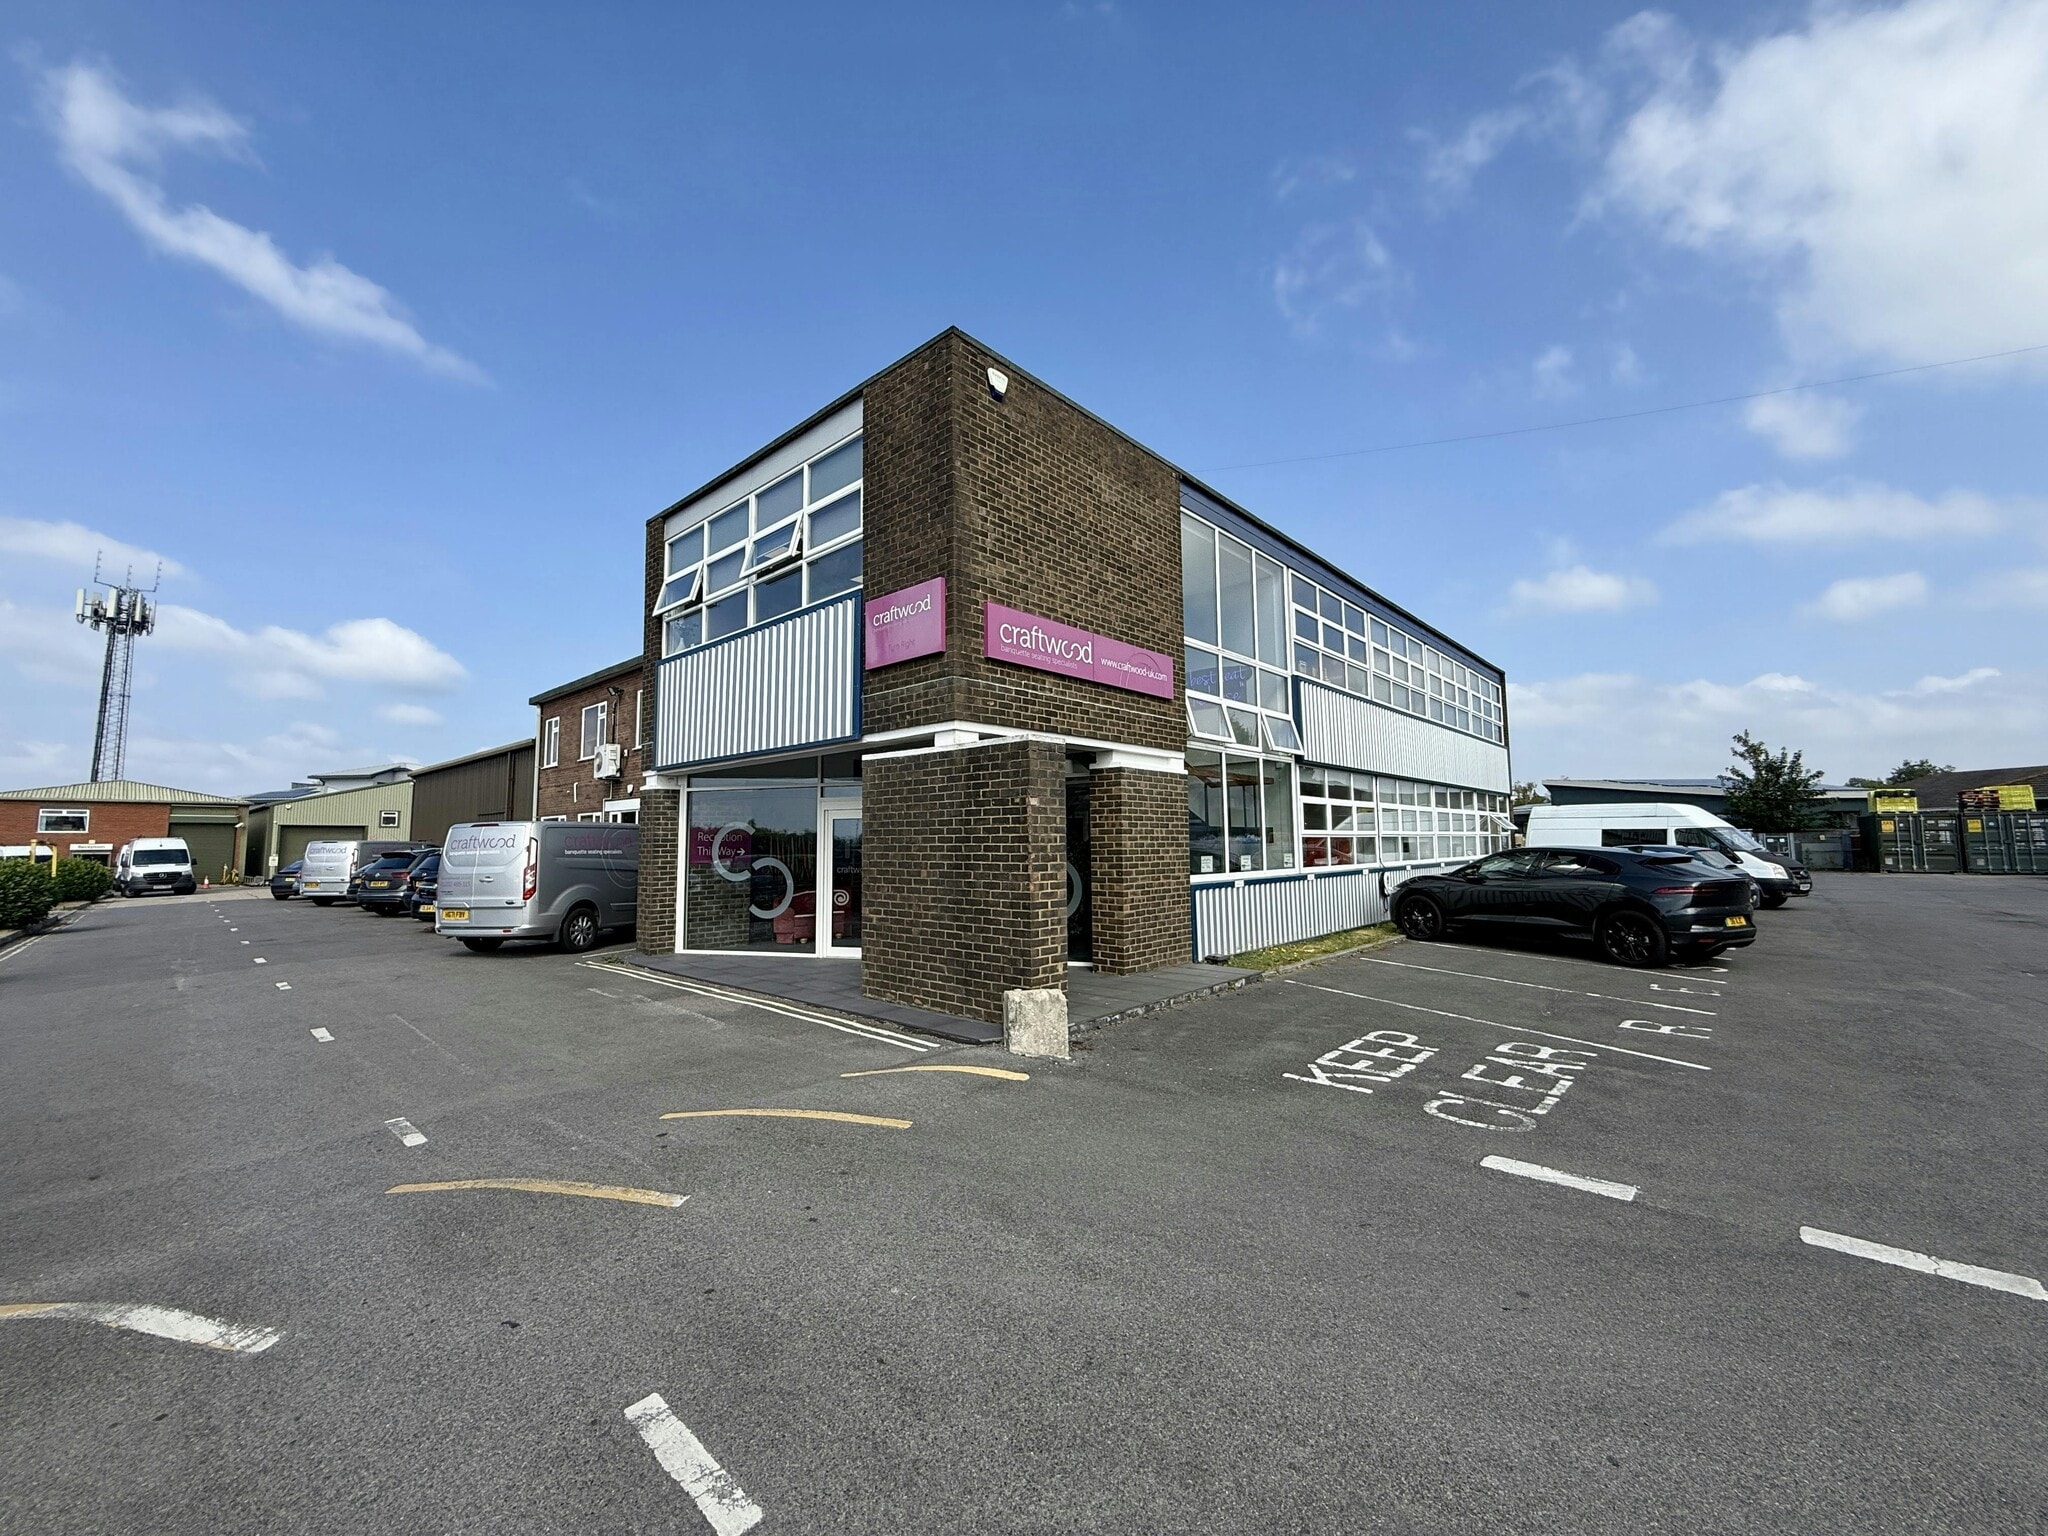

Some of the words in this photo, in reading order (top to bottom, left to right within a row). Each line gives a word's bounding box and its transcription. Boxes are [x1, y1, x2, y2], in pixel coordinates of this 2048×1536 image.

[873, 594, 931, 626] craftwood
[999, 623, 1094, 664] craftwood
[1000, 644, 1030, 657] banquette
[1031, 652, 1052, 664] seating
[1100, 657, 1168, 682] www.craftwood-uk.com
[1223, 666, 1246, 682] eat
[450, 834, 516, 850] craftwood
[697, 831, 743, 842] Rection
[697, 846, 713, 856] Thi
[1282, 1029, 1440, 1094] KEEP
[1422, 1041, 1598, 1133] CLEAR
